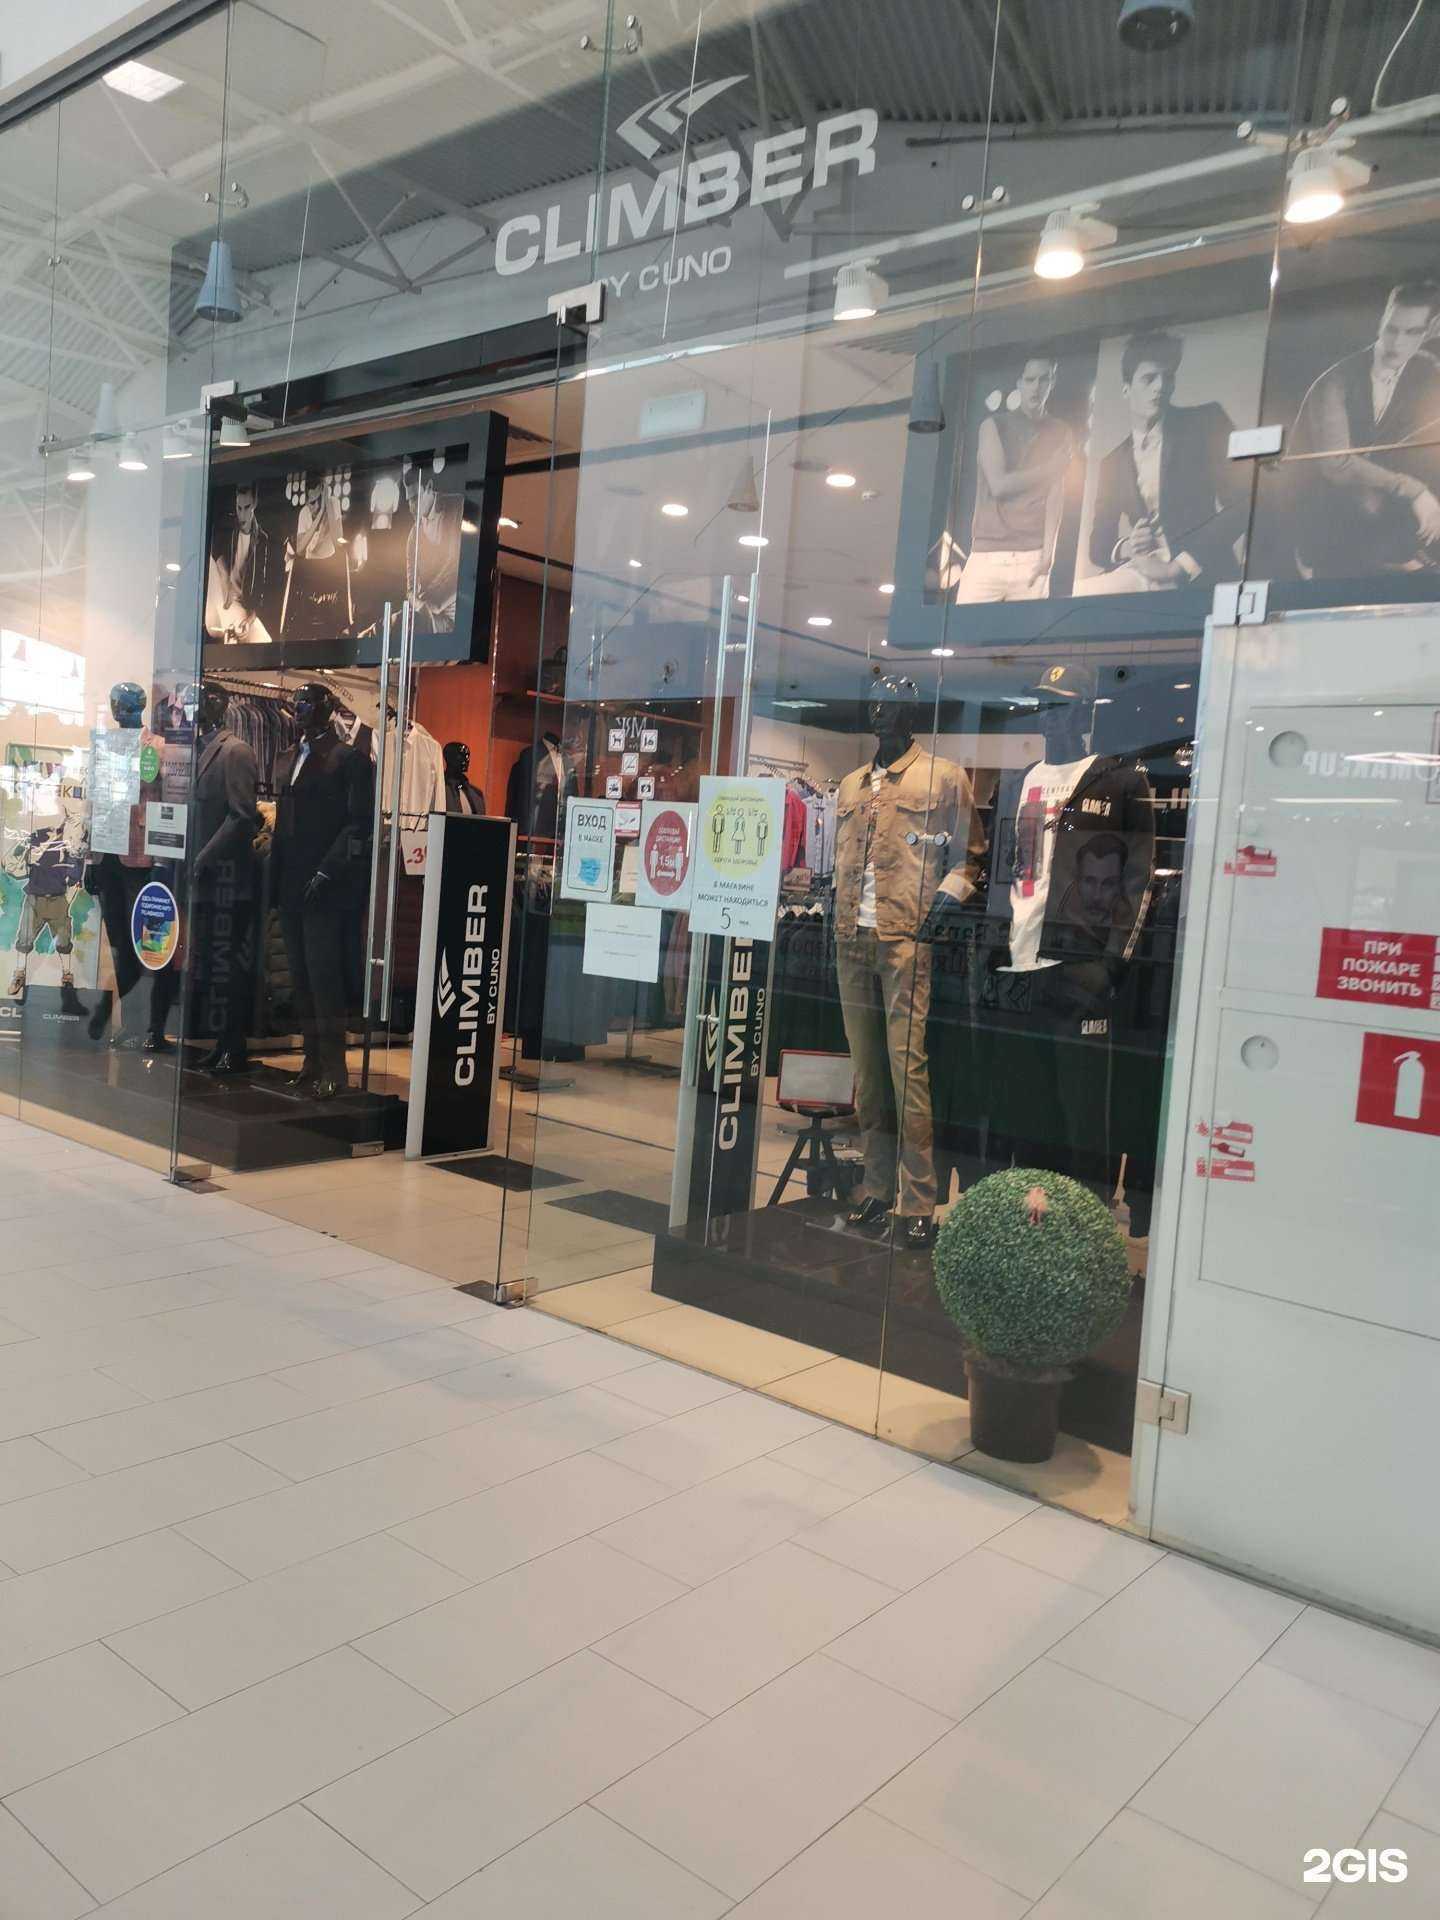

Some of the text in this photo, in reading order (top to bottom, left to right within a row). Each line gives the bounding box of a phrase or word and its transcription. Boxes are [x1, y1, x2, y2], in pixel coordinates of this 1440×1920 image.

[494, 108, 879, 276] CLIMBER
[639, 246, 732, 291] CUNO
[577, 814, 607, 831] ВХОД
[719, 881, 755, 892] МАГАЗИНЕ
[697, 893, 769, 907] МОЖЕТ НАХОДИТЬСЯ
[719, 907, 731, 930] 5
[1363, 940, 1403, 957] ПРИ
[1342, 957, 1421, 978] ПОЖАРЕ
[454, 883, 489, 1087] CLIMBER
[486, 947, 501, 1026] BY CUNO
[1337, 975, 1423, 997] ЗВОНИТЬ
[750, 987, 766, 1078] BY CUNO
